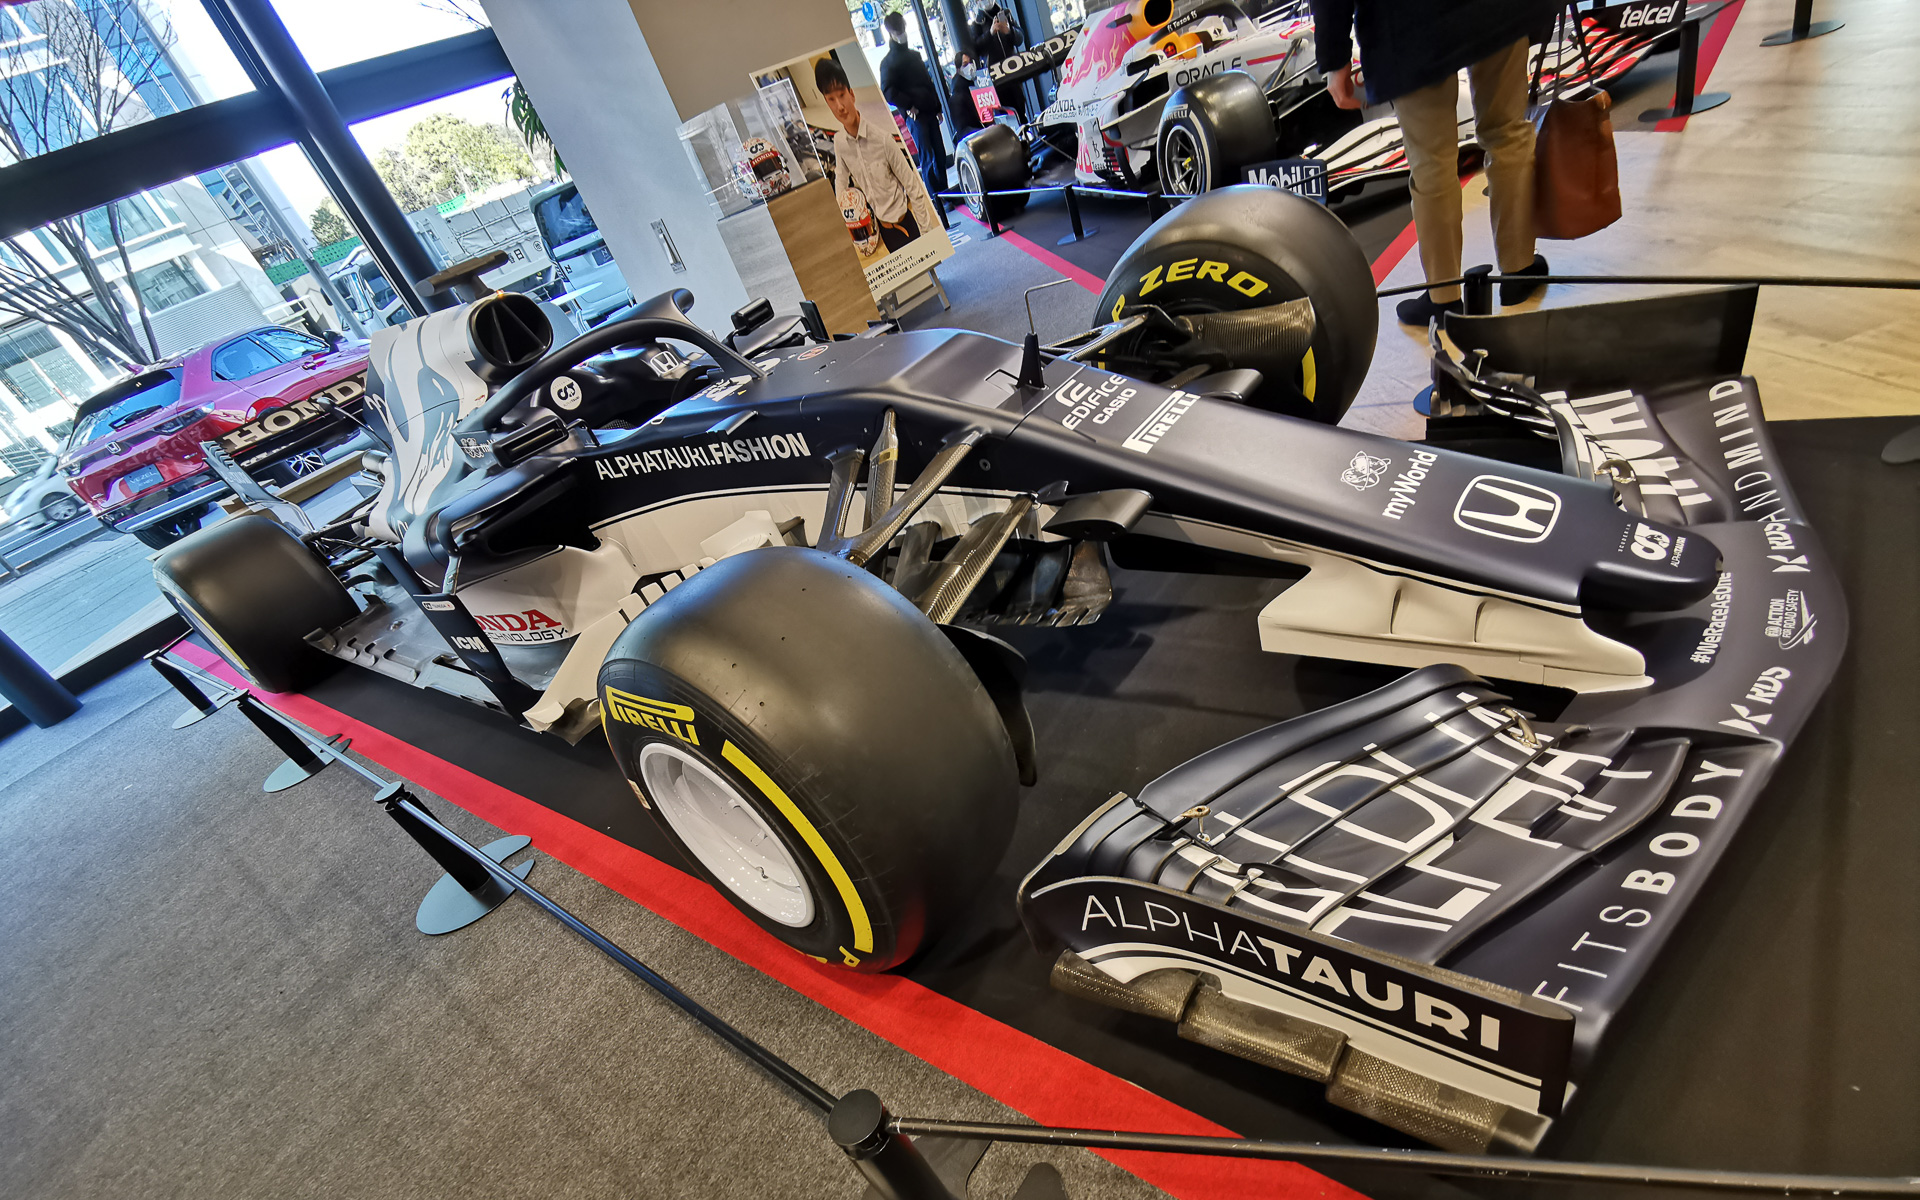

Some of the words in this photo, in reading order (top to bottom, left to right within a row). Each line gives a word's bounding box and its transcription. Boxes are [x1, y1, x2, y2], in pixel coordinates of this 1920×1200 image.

[1173, 15, 1191, 29] Tezos
[1620, 1, 1680, 29] telcel
[990, 29, 1079, 81] HONDA
[1175, 56, 1242, 87] ORACLE
[976, 90, 996, 108] ESSO
[751, 151, 775, 166] HONDA
[1248, 165, 1303, 195] Mobil
[1138, 257, 1269, 298] ZERO
[223, 370, 367, 451] HOND
[1061, 374, 1128, 431] EDIFICE
[1092, 387, 1138, 425] CASIO
[1121, 389, 1202, 454] PIRELLI
[127, 468, 158, 487] VEZEL
[1381, 449, 1439, 520] myWorld
[1767, 598, 1786, 627] ACTION
[1786, 588, 1800, 612] SAFETY
[474, 608, 562, 632] NDA
[1689, 571, 1732, 664] #WeRaceAsOne
[1781, 627, 1793, 639] FOR
[1783, 611, 1798, 630] ROAD
[605, 684, 701, 746] PIRELLI
[1532, 905, 1652, 1013] FITS
[1620, 759, 1744, 895] BODY
[1081, 893, 1501, 1052] ALPHATAURI
